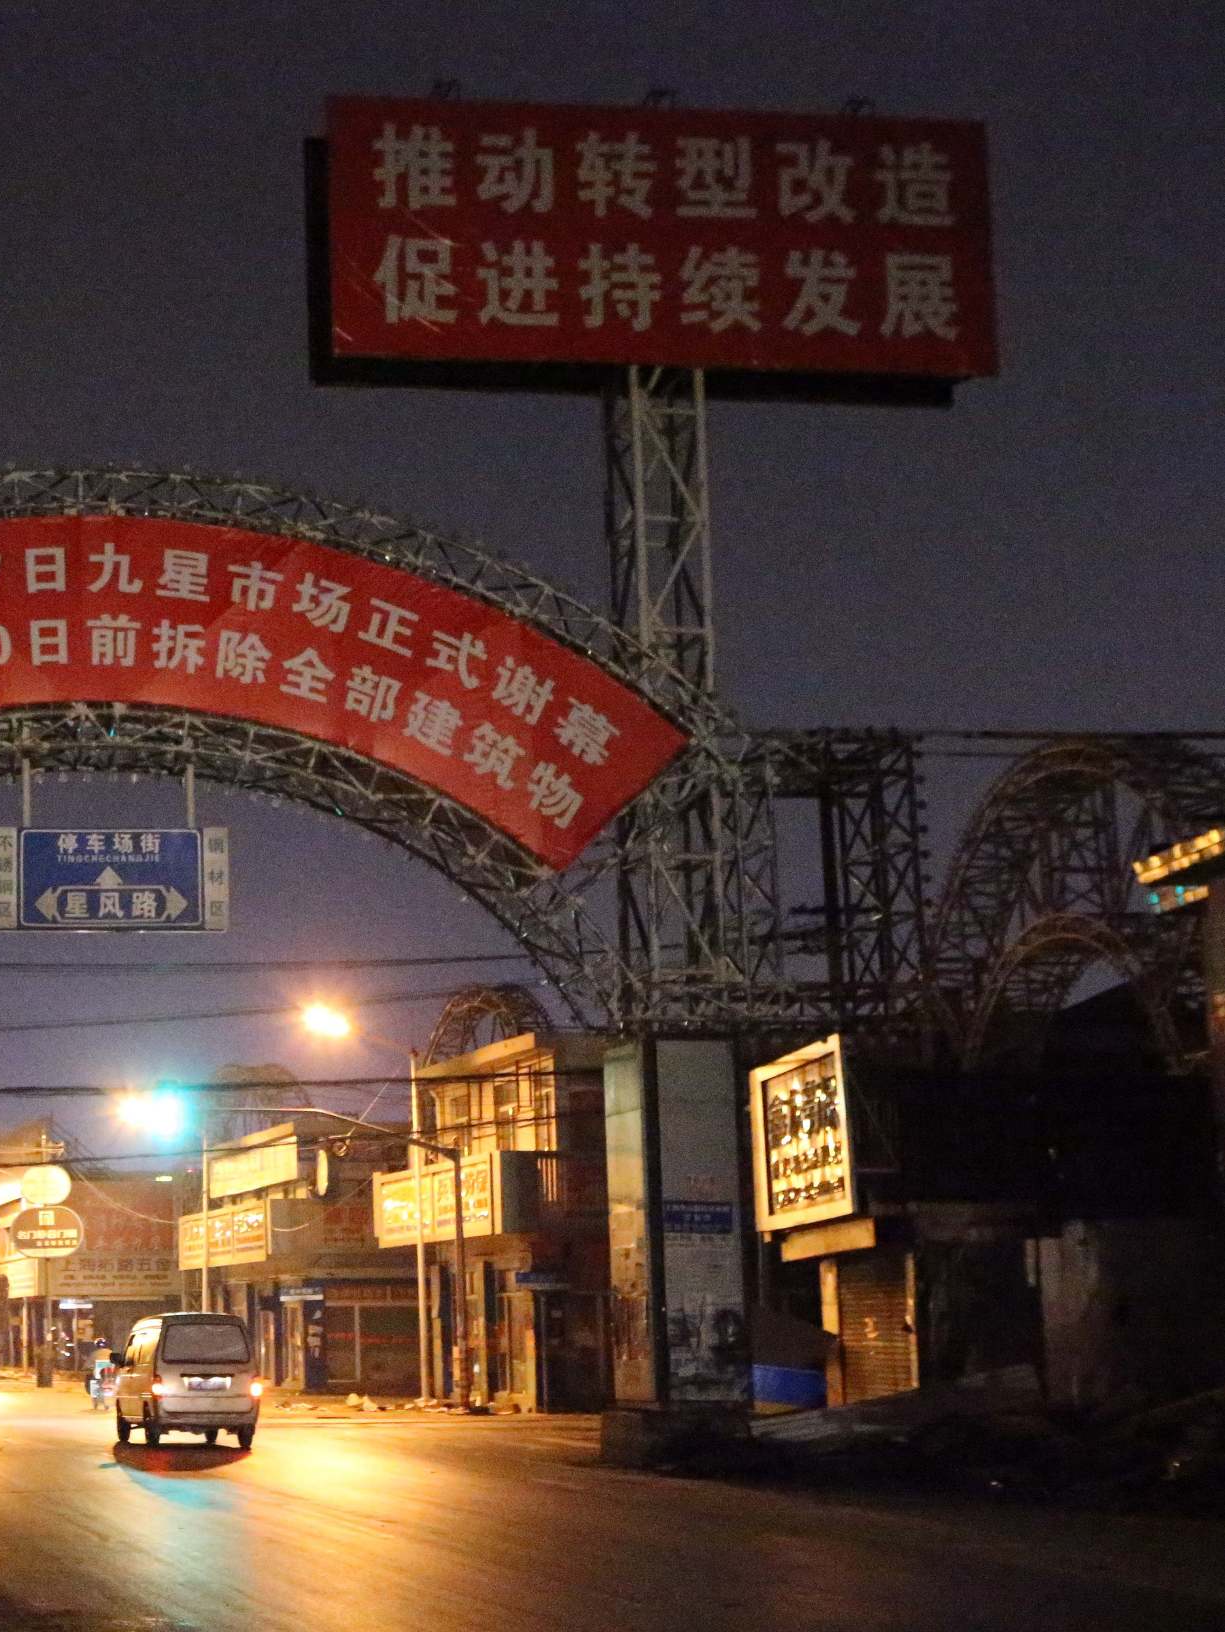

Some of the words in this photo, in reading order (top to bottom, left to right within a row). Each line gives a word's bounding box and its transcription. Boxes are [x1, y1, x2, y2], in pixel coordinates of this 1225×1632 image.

[374, 121, 956, 227] 推动转型改造
[375, 234, 958, 342] 促进持续发展
[57, 833, 161, 854] 停车场街
